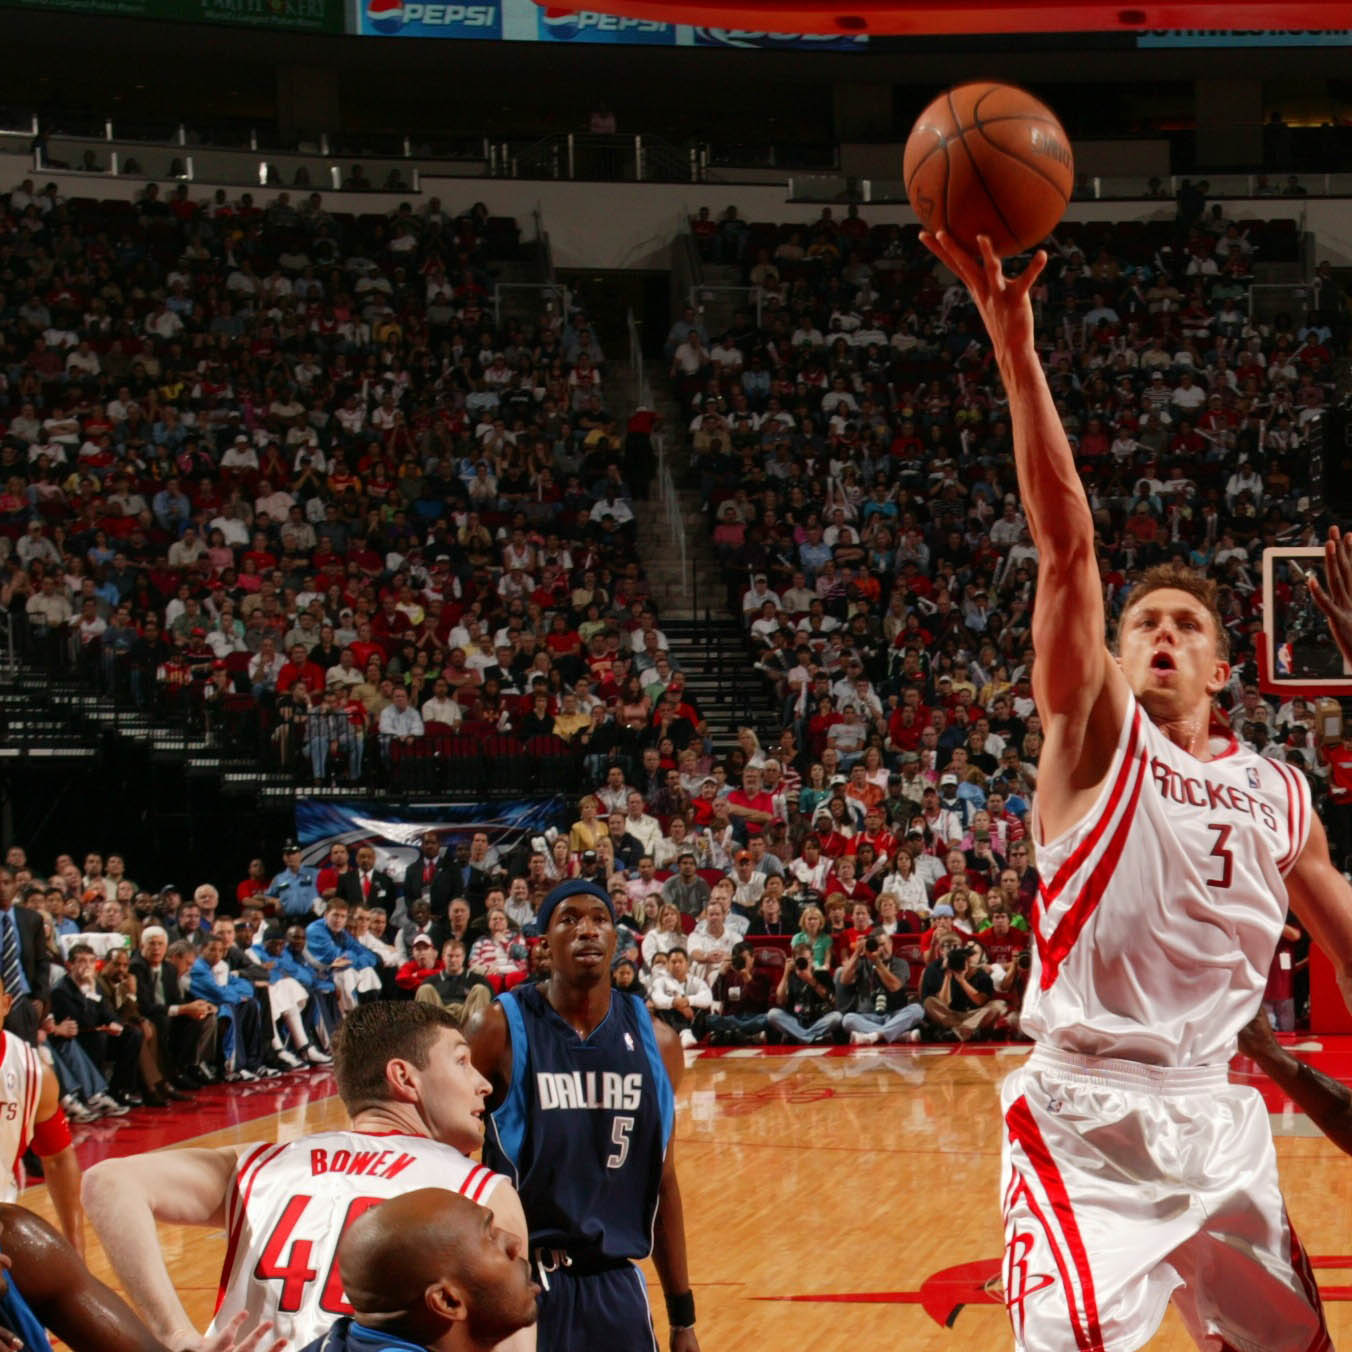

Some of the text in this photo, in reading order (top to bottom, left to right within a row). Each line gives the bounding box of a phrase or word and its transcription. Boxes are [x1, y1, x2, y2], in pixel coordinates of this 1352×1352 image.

[402, 4, 496, 27] PEPSI
[1150, 756, 1277, 832] ROCKETS
[1206, 823, 1233, 888] 3
[537, 1071, 643, 1111] DALLAS
[310, 1148, 416, 1180] BOWEN
[607, 1116, 635, 1169] 5
